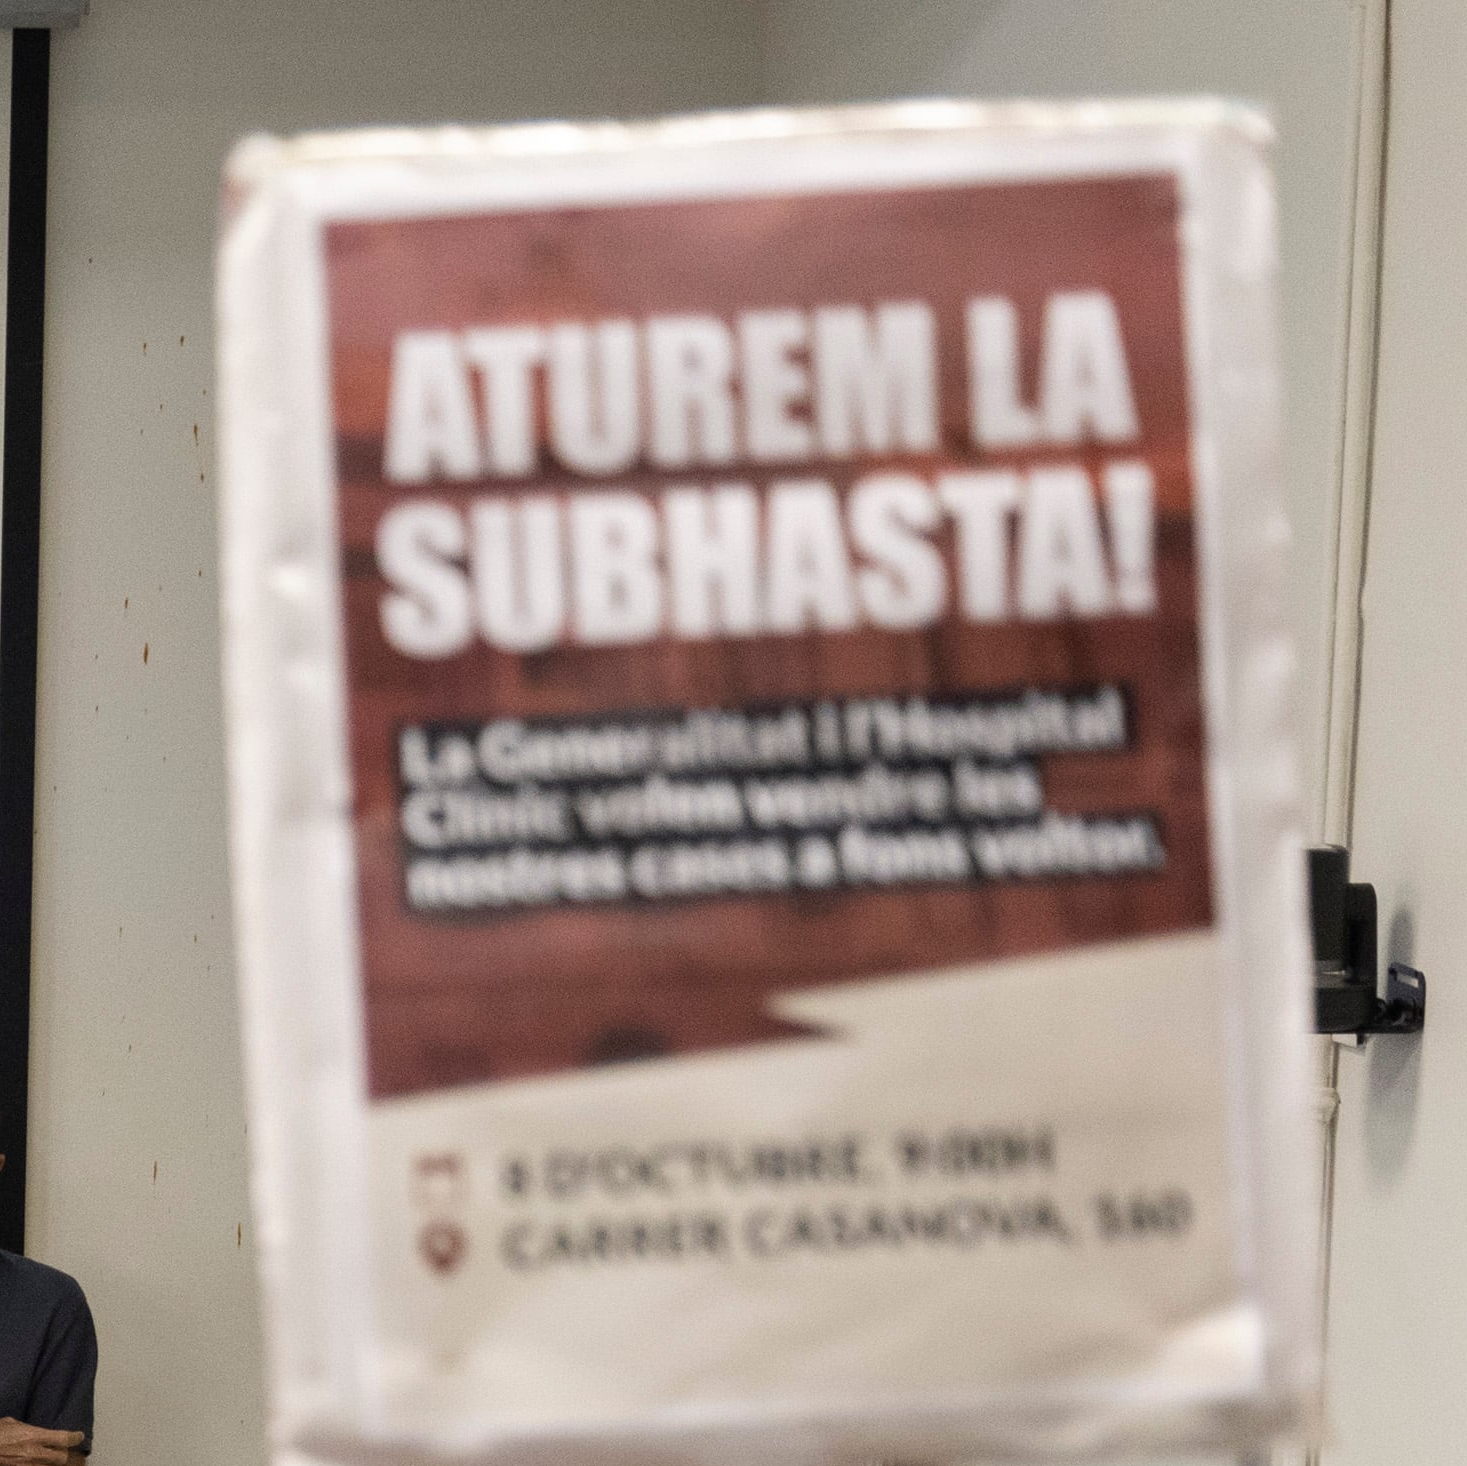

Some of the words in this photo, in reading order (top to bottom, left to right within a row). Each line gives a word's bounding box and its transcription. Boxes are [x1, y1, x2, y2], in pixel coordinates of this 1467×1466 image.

[384, 297, 940, 483] ATUREM
[965, 291, 1139, 450] LA
[374, 462, 1158, 658] SUBHASTA!
[399, 723, 473, 786] La
[578, 776, 744, 835] volen
[747, 762, 949, 826] vendre
[954, 756, 1044, 814] les
[499, 1213, 729, 1273] CARRER
